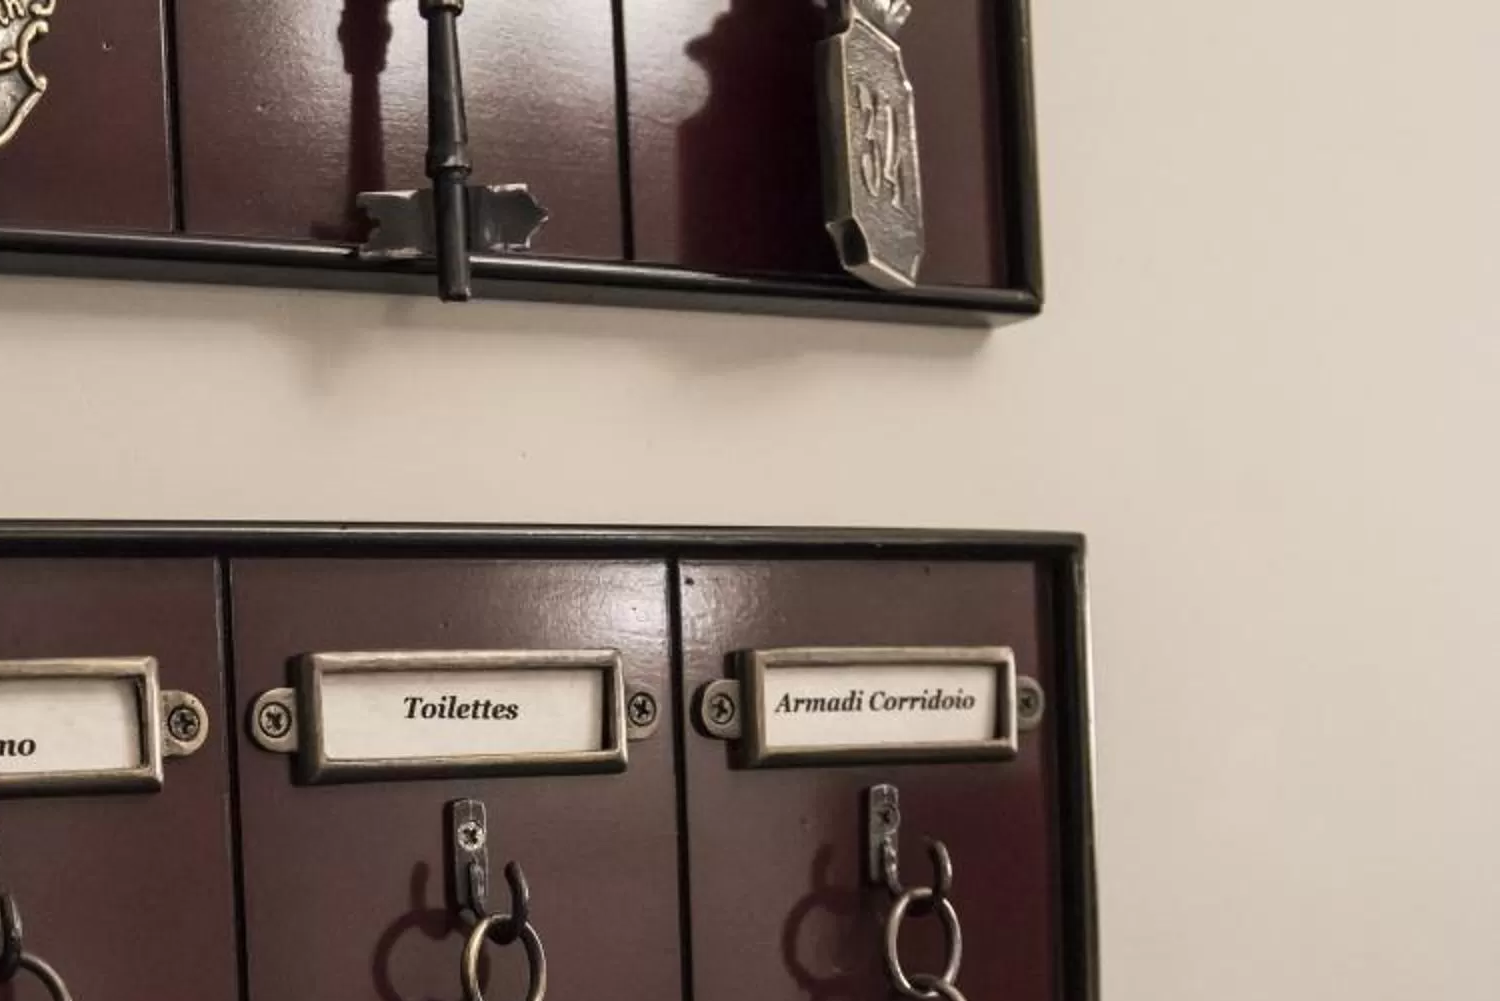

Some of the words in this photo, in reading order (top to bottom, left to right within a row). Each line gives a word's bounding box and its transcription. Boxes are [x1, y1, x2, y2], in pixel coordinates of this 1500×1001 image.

[403, 695, 520, 721] Toilettes
[773, 689, 865, 713] Armadi
[868, 687, 976, 712] Corridoio
